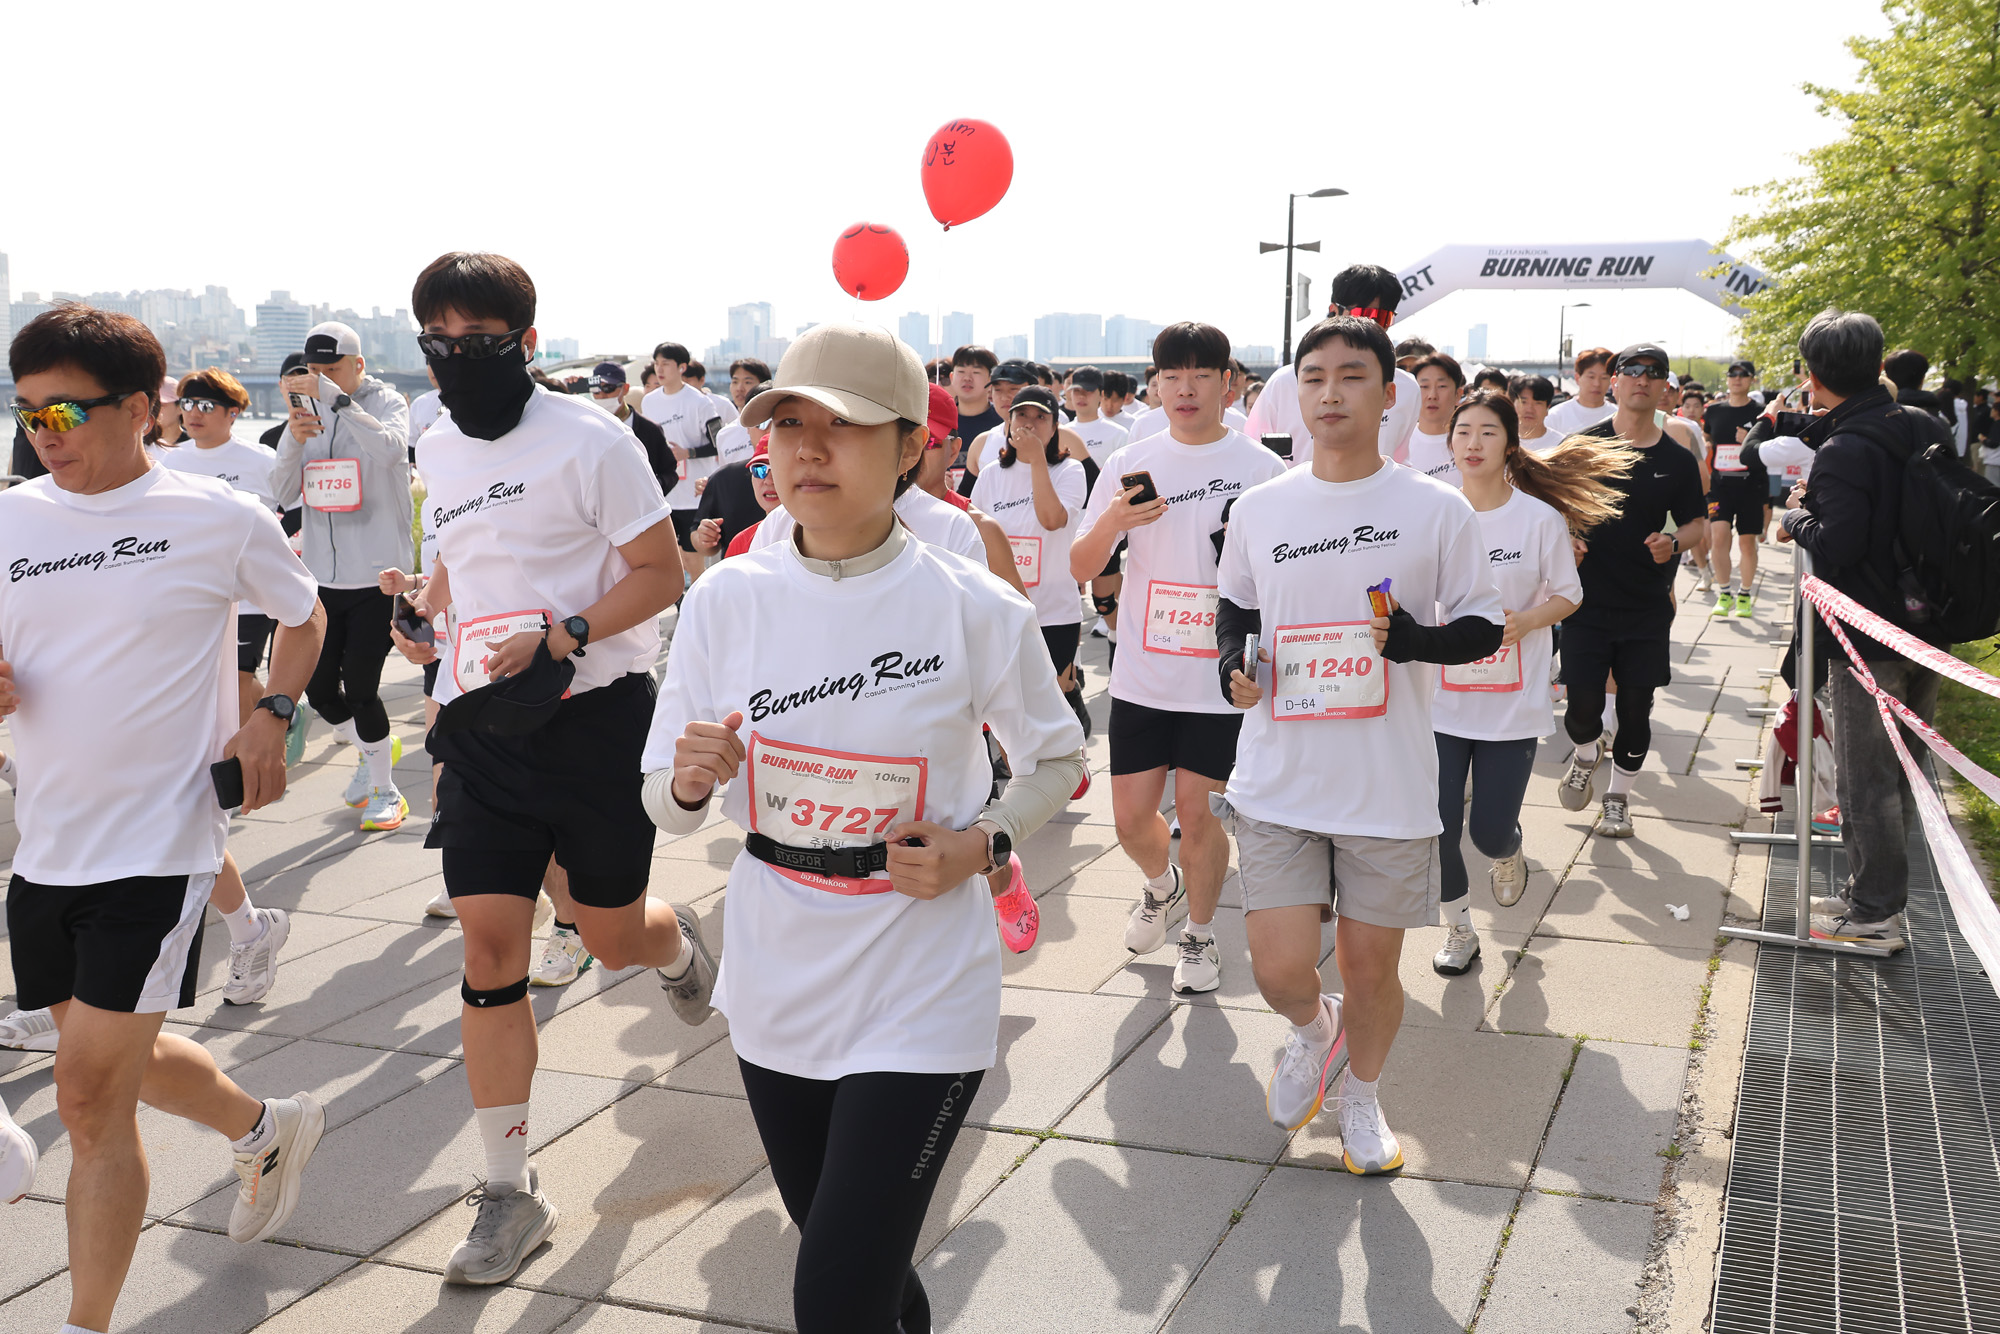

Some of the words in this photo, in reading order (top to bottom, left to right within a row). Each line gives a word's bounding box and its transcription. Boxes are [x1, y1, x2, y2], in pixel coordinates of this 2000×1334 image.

[1480, 257, 1592, 277] BURNING
[1596, 256, 1654, 276] RUN
[1400, 265, 1435, 301] RT
[307, 481, 315, 489] M
[317, 478, 352, 490] 1736
[1164, 488, 1207, 505] urning
[1208, 479, 1242, 494] Run
[433, 495, 484, 528] Burning
[486, 482, 525, 503] Run
[993, 496, 1030, 512] Burning
[1272, 537, 1350, 563] Burning
[1353, 525, 1400, 546] Run
[9, 550, 108, 582] Burning
[112, 536, 171, 561] Run
[123, 558, 145, 566] Running
[1013, 555, 1032, 566] 38
[1488, 548, 1522, 563] Run
[1154, 588, 1182, 597] BURNING
[1154, 610, 1165, 620] M
[1168, 609, 1215, 627] 1243
[492, 624, 509, 635] RUN
[520, 621, 541, 630] 10km
[1281, 633, 1320, 643] BURNING
[1322, 632, 1343, 641] RUN
[1353, 631, 1374, 639] 10k
[1153, 634, 1171, 643] C-54
[464, 660, 474, 673] M
[1285, 663, 1300, 676] M
[1306, 656, 1373, 678] 1240
[748, 672, 867, 722] Burning
[870, 651, 944, 686] Run
[864, 687, 887, 698] Casual
[889, 681, 916, 693] Running
[917, 676, 941, 686] Festival
[1318, 684, 1341, 693] 김하늘
[1285, 698, 1316, 710] D-64
[760, 753, 823, 774] BURNING
[825, 765, 858, 780] RUN
[874, 772, 910, 784] 10km
[791, 770, 810, 778] Casual
[810, 773, 831, 784] Running
[765, 792, 788, 811] W
[791, 798, 899, 835] 3727
[775, 849, 826, 867] GTXSPOR
[911, 1080, 964, 1180] Columbia
